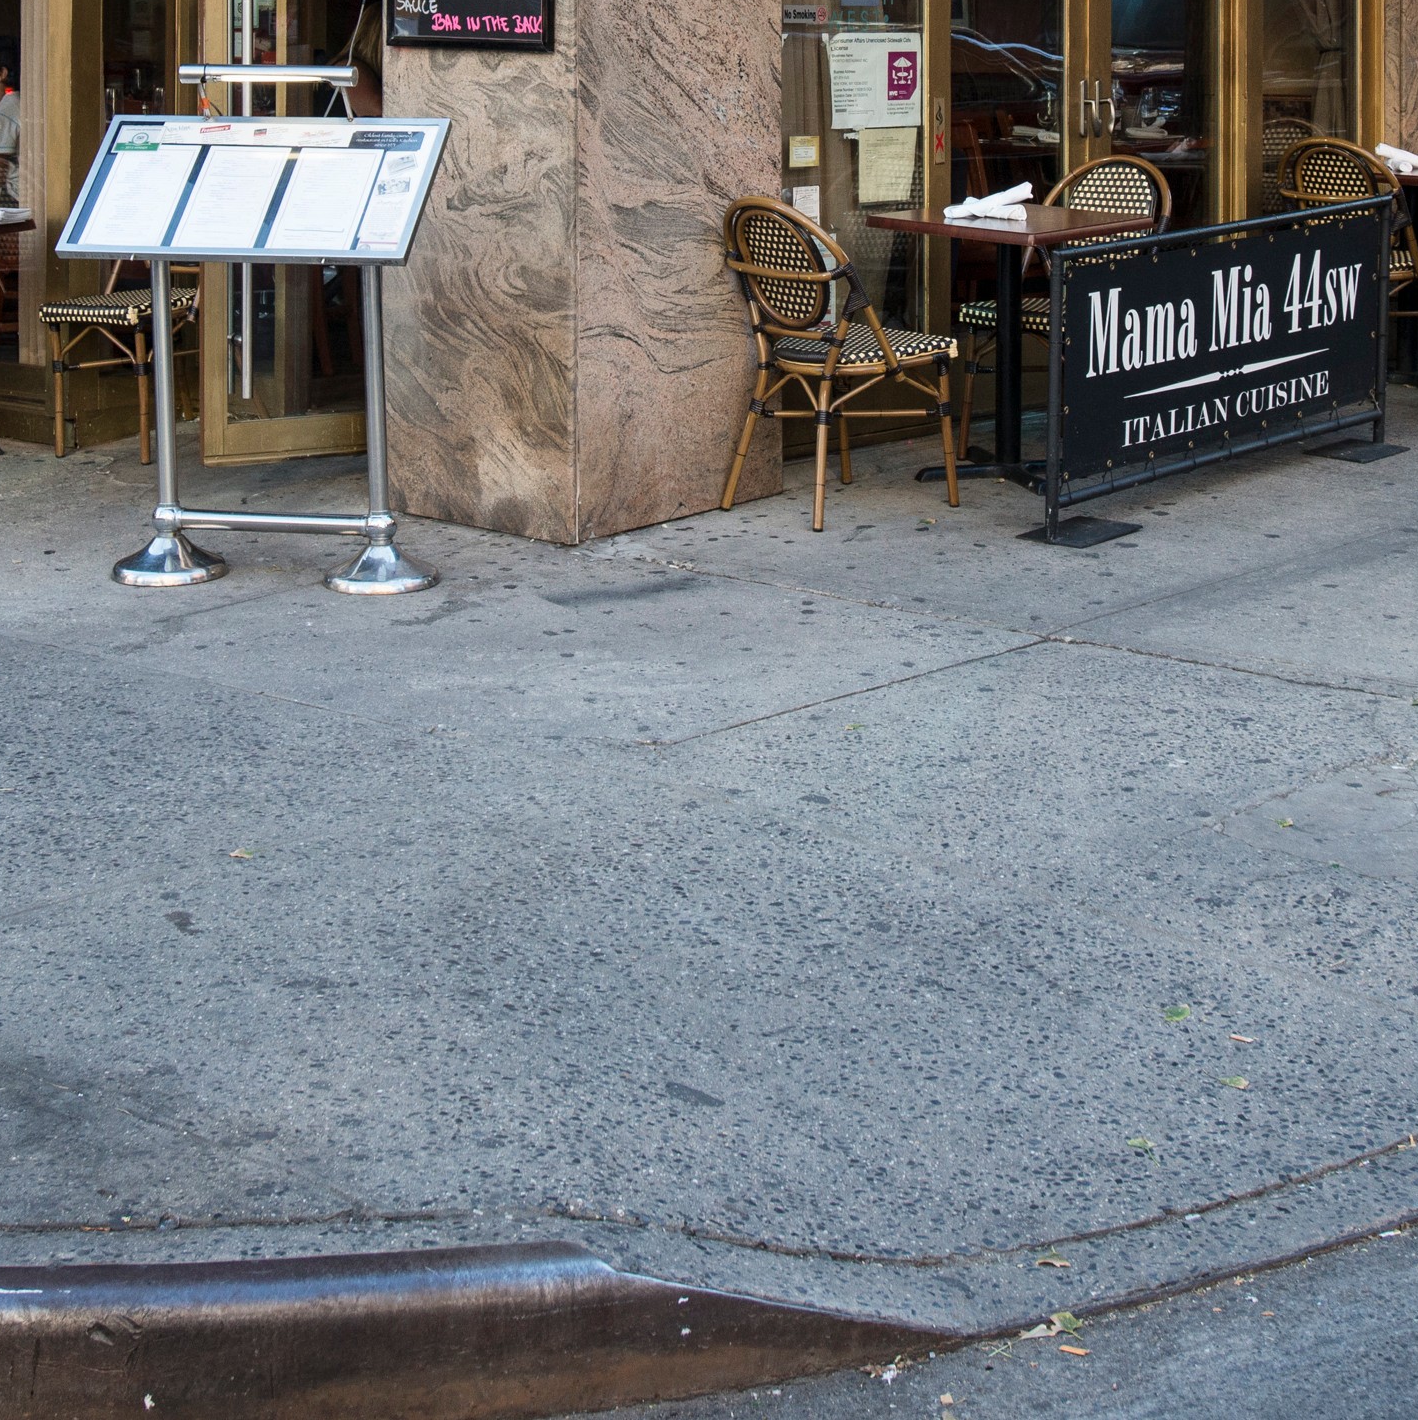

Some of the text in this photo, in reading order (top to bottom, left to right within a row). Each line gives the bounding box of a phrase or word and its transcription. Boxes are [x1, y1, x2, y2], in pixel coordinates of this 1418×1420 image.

[432, 13, 542, 34] BAR IN THE BACK
[784, 9, 817, 21] No Smoking
[1086, 287, 1197, 378] Mama
[1209, 264, 1272, 352] Mia
[1121, 370, 1329, 448] ITALIAN CUISINE
